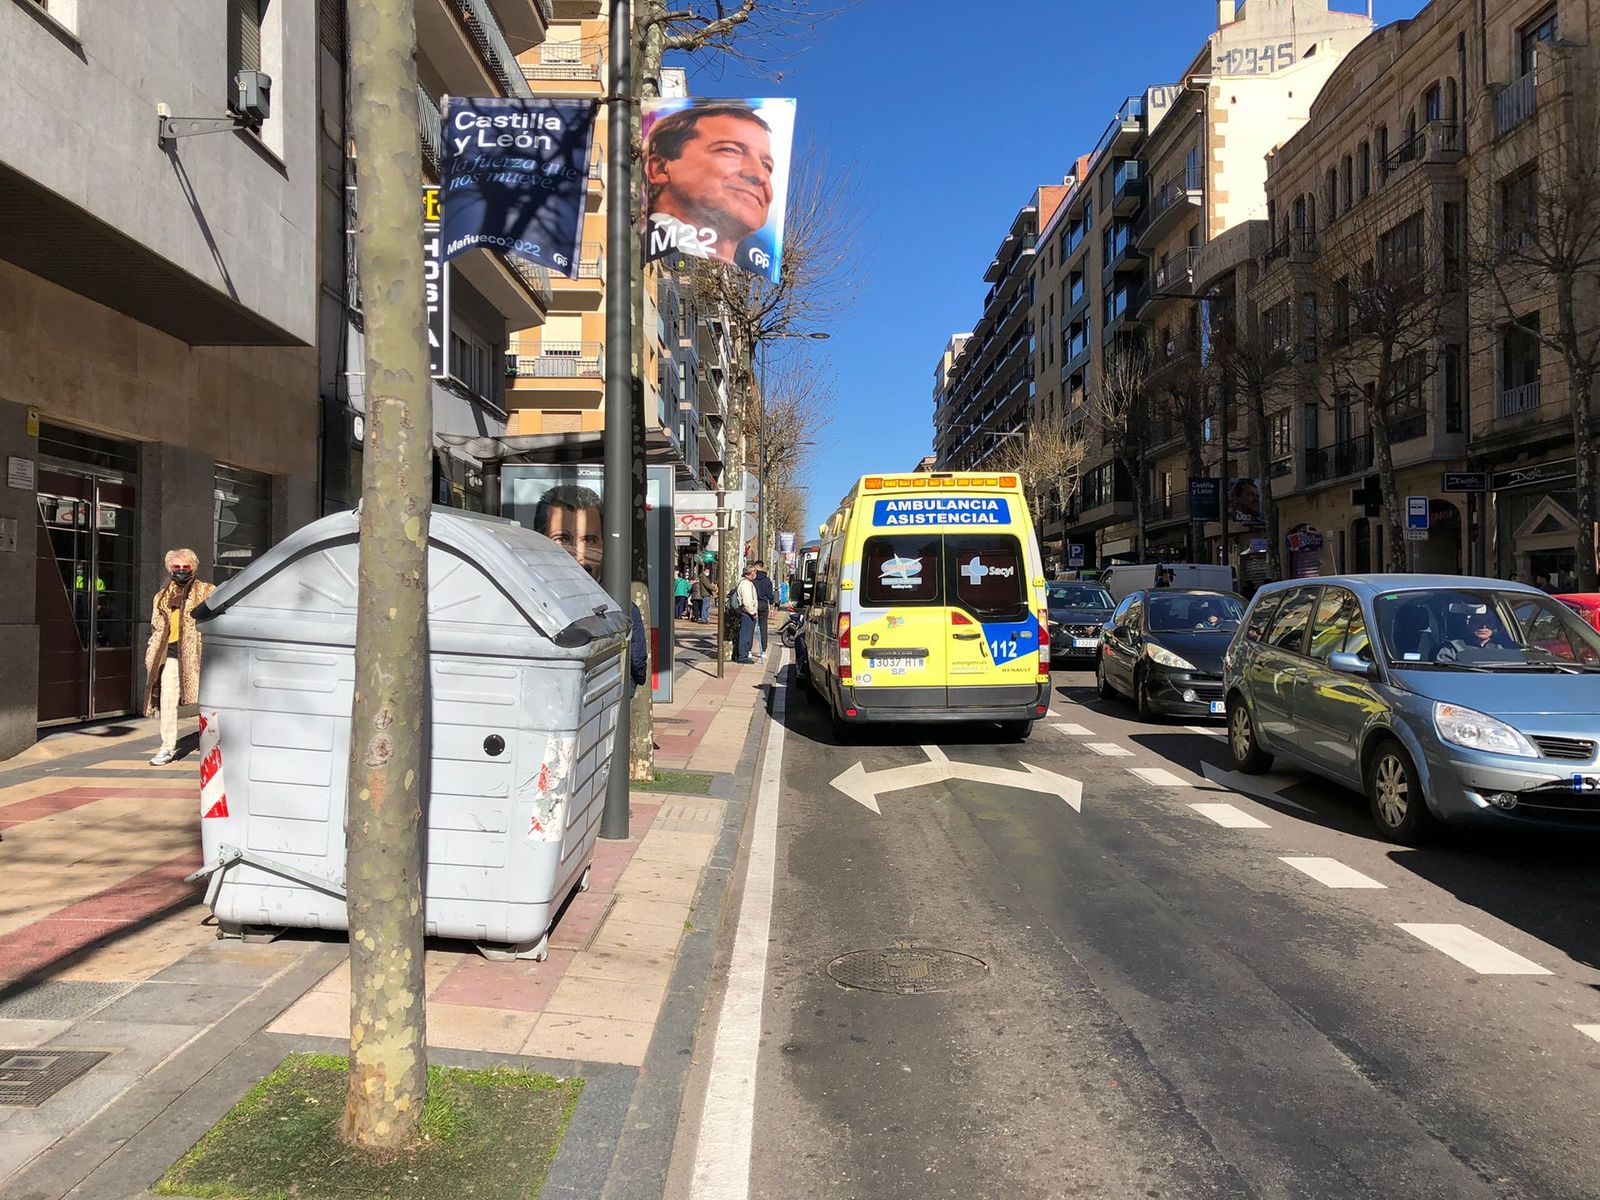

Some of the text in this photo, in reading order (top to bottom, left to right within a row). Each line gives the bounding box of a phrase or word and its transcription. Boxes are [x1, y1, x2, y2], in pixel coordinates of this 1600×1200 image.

[455, 111, 561, 130] Castilla
[453, 129, 551, 157] y León
[451, 154, 577, 180] la fuerza que
[450, 172, 479, 190] nos
[447, 234, 540, 257] Mañueco2022
[1191, 481, 1214, 489] Castilla
[886, 500, 999, 511] AMBULANCIA
[886, 513, 999, 525] ASISTENCIAL
[991, 640, 1017, 658] 112
